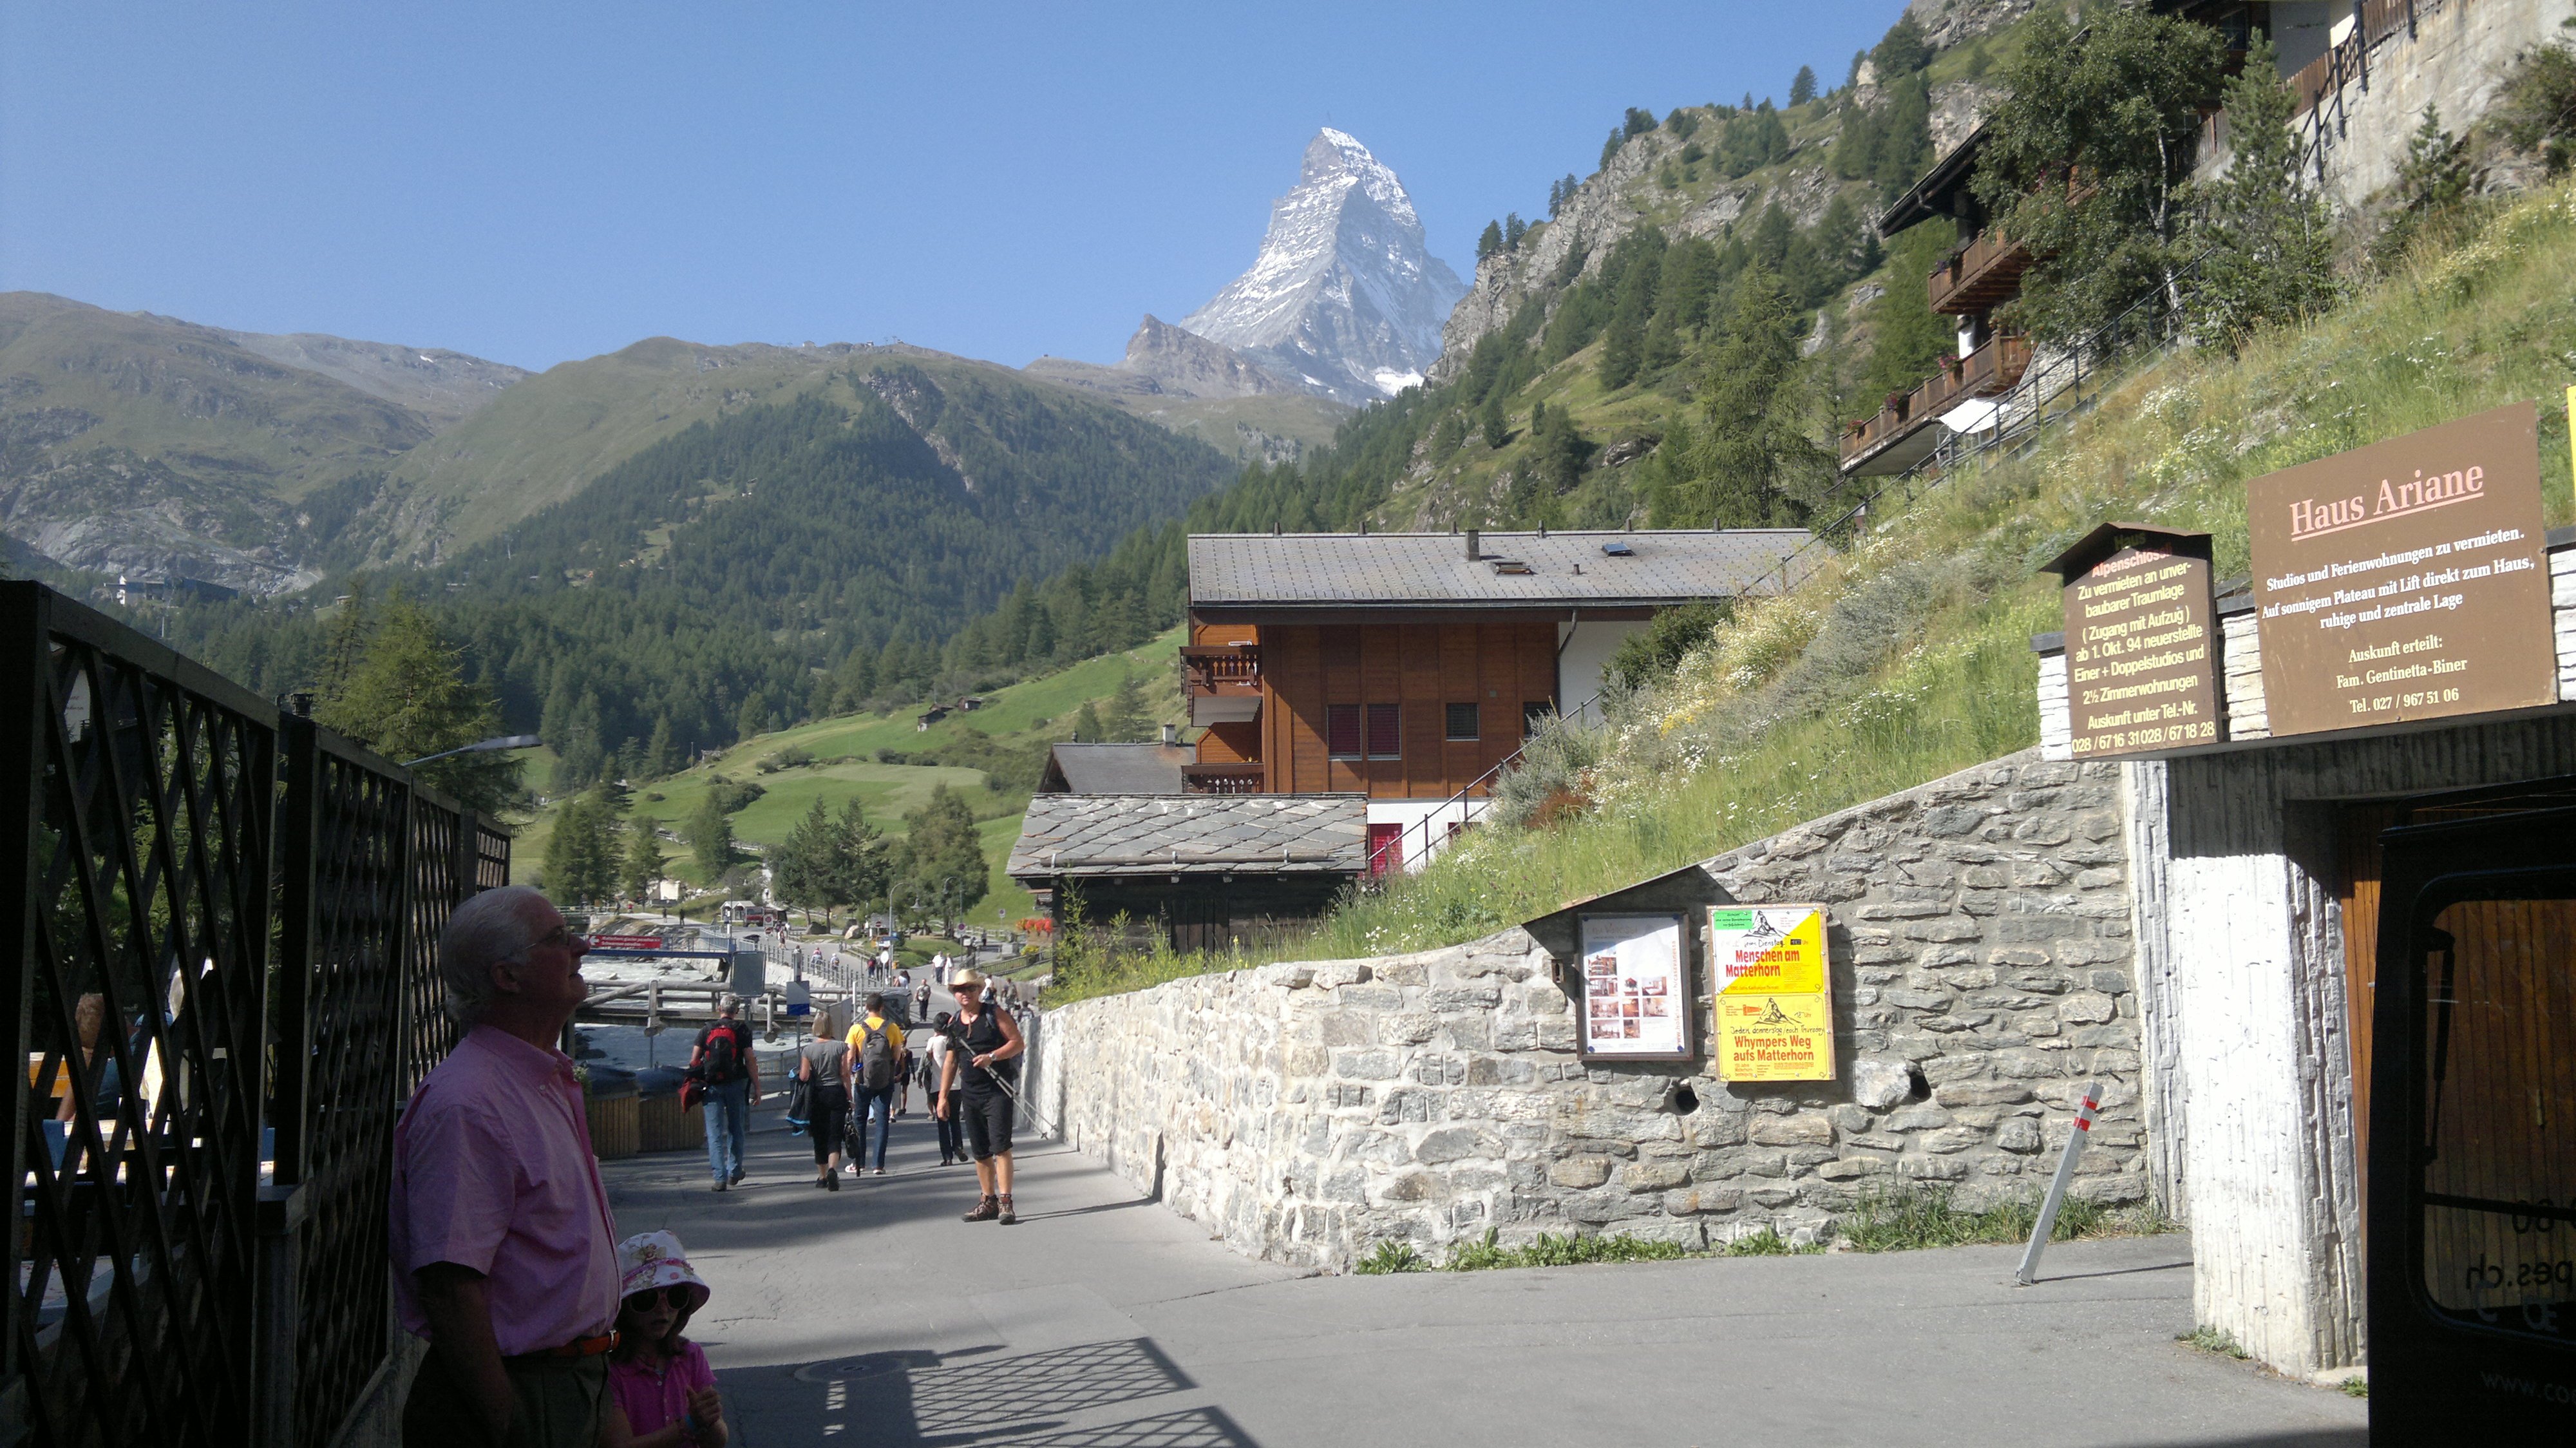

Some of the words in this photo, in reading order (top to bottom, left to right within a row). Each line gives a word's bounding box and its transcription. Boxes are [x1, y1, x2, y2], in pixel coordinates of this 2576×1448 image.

[2289, 496, 2365, 535] Haus
[2372, 466, 2484, 515] Ariane
[2114, 532, 2146, 551] Haus
[2267, 573, 2307, 591] Studios
[2307, 567, 2329, 582] und
[2331, 547, 2433, 577] Ferienwohnungen
[2436, 543, 2451, 555] zu
[2453, 529, 2524, 551] vermieten.
[2078, 586, 2093, 602] Zu
[2094, 576, 2143, 596] vermieten
[2144, 571, 2158, 584] an
[2159, 562, 2192, 580] unver-
[2262, 602, 2280, 619] Auf
[2281, 597, 2332, 614] sonnigem
[2333, 588, 2376, 605] Plateau
[2378, 581, 2398, 596] mit
[2400, 576, 2421, 592] Lift
[2423, 569, 2460, 587] direkt
[2462, 566, 2491, 580] zum
[2493, 556, 2535, 574] Haus,
[2086, 596, 2130, 617] baubarer
[2131, 584, 2184, 604] Traumlage
[2320, 614, 2356, 630] ruhige
[2358, 605, 2382, 622] und
[2384, 599, 2431, 618] zentrale
[2433, 594, 2463, 610] Lage
[2088, 622, 2128, 641] Zugang
[2130, 616, 2146, 631] mit
[2148, 609, 2184, 627] Aufzug
[2076, 647, 2090, 662] ab
[2091, 645, 2101, 659] 1.
[2102, 640, 2123, 656] Okt.
[2126, 637, 2142, 653] 94
[2144, 625, 2203, 647] neuerstellte
[2349, 641, 2400, 665] Auskunft
[2403, 635, 2442, 653] erteilt:
[2074, 667, 2101, 682] Einer
[2111, 653, 2184, 676] Doppelstudios
[2186, 643, 2204, 662] und
[2336, 675, 2363, 689] Fam.
[2366, 660, 2467, 683] Gentinetta-Biner
[2101, 675, 2198, 701] Zimmerwohnungen
[2349, 698, 2371, 713] Tel.
[2373, 696, 2392, 710] 027
[2396, 694, 2400, 709] /
[2403, 692, 2424, 707] 967
[2427, 691, 2439, 704] 51
[2443, 688, 2459, 701] 06
[2088, 712, 2132, 730] Auskunft
[2132, 707, 2160, 723] unter
[2161, 700, 2198, 719] Tel.-Nr.
[2200, 721, 2215, 737] 28
[1726, 964, 1781, 977] Matterhorn
[1736, 949, 1783, 962] Menschen
[1785, 950, 1800, 962] am
[1734, 1036, 1787, 1050] Whympers
[1790, 1035, 1811, 1049] Weg
[1734, 1051, 1755, 1061] aufs
[1757, 1049, 1814, 1061] Matterhorn
